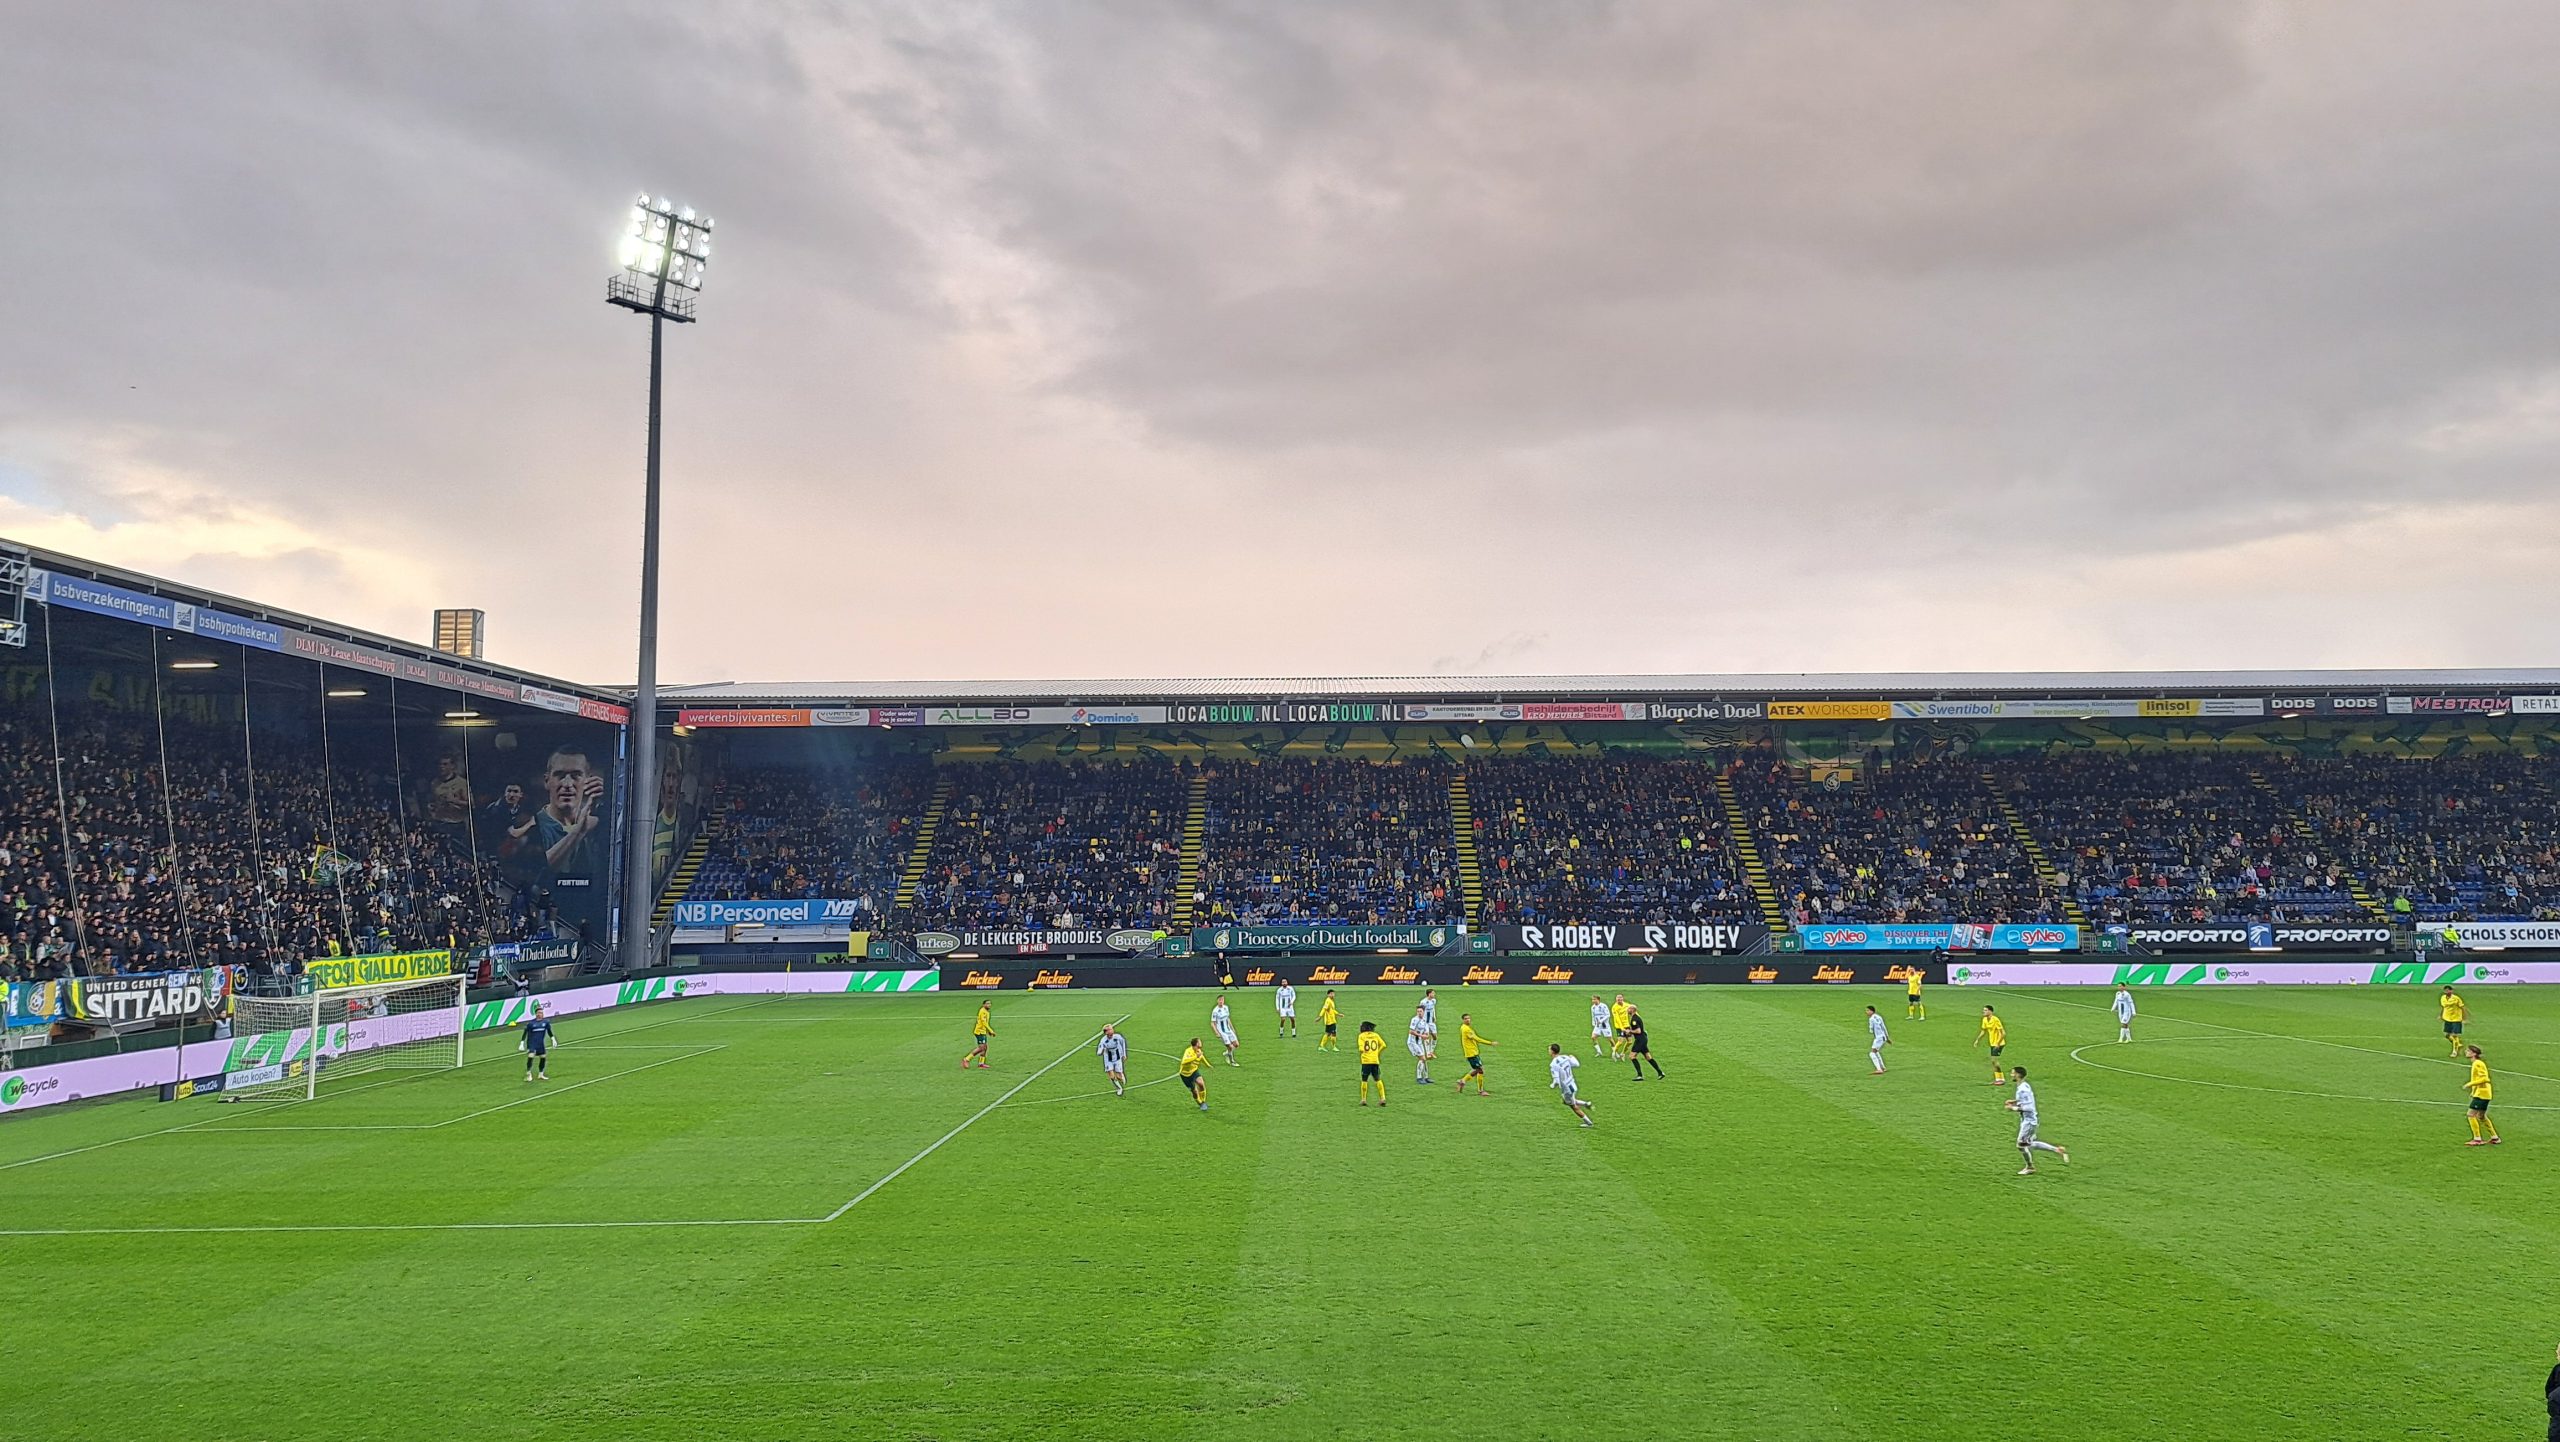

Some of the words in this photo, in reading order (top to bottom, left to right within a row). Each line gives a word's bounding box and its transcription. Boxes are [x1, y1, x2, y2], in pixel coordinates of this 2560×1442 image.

[54, 580, 169, 620] bsbverzekeringen.nl
[199, 614, 278, 645] bsbhypotheken.nl
[296, 637, 316, 654] DLM
[330, 646, 351, 660] Lease
[438, 671, 453, 683] DLM
[465, 677, 481, 690] Lease
[1527, 704, 1616, 713] schildersbedrijf
[1769, 705, 1805, 715] ATEX
[1807, 704, 1889, 715] WORKSHOP
[1928, 703, 2002, 715] Swentibold
[2146, 700, 2191, 711] linisol
[2271, 699, 2316, 709] DODS
[2333, 698, 2378, 708] DODS
[2413, 697, 2511, 710] MESTROM
[689, 710, 802, 724] werkenbijvivantes.nl
[938, 709, 1030, 720] ALLBO
[1088, 712, 1139, 722] Domino's
[1168, 705, 1281, 722] LOCABOUW.NL
[1288, 704, 1401, 722] LOCABOUW.NL
[1650, 703, 1720, 719] Blanche
[1723, 703, 1762, 718] Dael
[677, 904, 707, 922] NB
[710, 901, 809, 921] Personeel
[824, 900, 858, 916] NB
[964, 931, 978, 945] DE
[981, 931, 1046, 945] LEKKERSTE
[1046, 930, 1103, 945] BROODJES
[1238, 931, 1299, 945] Pioneers
[1302, 930, 1316, 945] of
[1319, 929, 1363, 945] Dutch
[1365, 929, 1422, 945] football.
[1551, 925, 1617, 949] ROBEY
[1674, 925, 1741, 949] ROBEY
[1823, 928, 1867, 946] syNeo
[1884, 930, 1930, 938] DISCOVER
[1933, 930, 1949, 938] THE
[1915, 937, 1948, 945] EFFECT
[2021, 928, 2066, 946] syNeo
[2134, 929, 2248, 943] PROFORTO
[2274, 929, 2391, 943] PROFORTO
[875, 947, 884, 955] C1
[1020, 945, 1030, 953] EN
[1030, 943, 1047, 952] MEER
[1170, 943, 1180, 951] C2
[2102, 940, 2112, 948] D2
[526, 945, 546, 962] Dutch
[358, 956, 408, 984] GIALLO
[408, 953, 449, 977] VERDE
[1246, 967, 1275, 981] ickers
[1308, 965, 1350, 981] Snickers
[1377, 965, 1420, 980] Snickers
[1462, 965, 1504, 980] Snickers
[1532, 965, 1574, 980] Snickers
[1748, 965, 1780, 980] ickers
[1812, 965, 1855, 980] Snickers
[1883, 965, 1926, 980] Snickrs
[1962, 969, 1992, 980] wecycle
[2220, 969, 2250, 979] wecycle
[2479, 968, 2510, 978] wecycle
[86, 980, 128, 993] UNITED
[131, 974, 203, 990] GENERNS
[679, 979, 708, 991] wecycle
[961, 970, 1004, 986] Snickers
[87, 985, 202, 1019] SITTARD
[1364, 1040, 1378, 1052] 80
[232, 1074, 249, 1085] Auto
[251, 1069, 277, 1083] kopen?
[11, 1075, 59, 1098] wecycle
